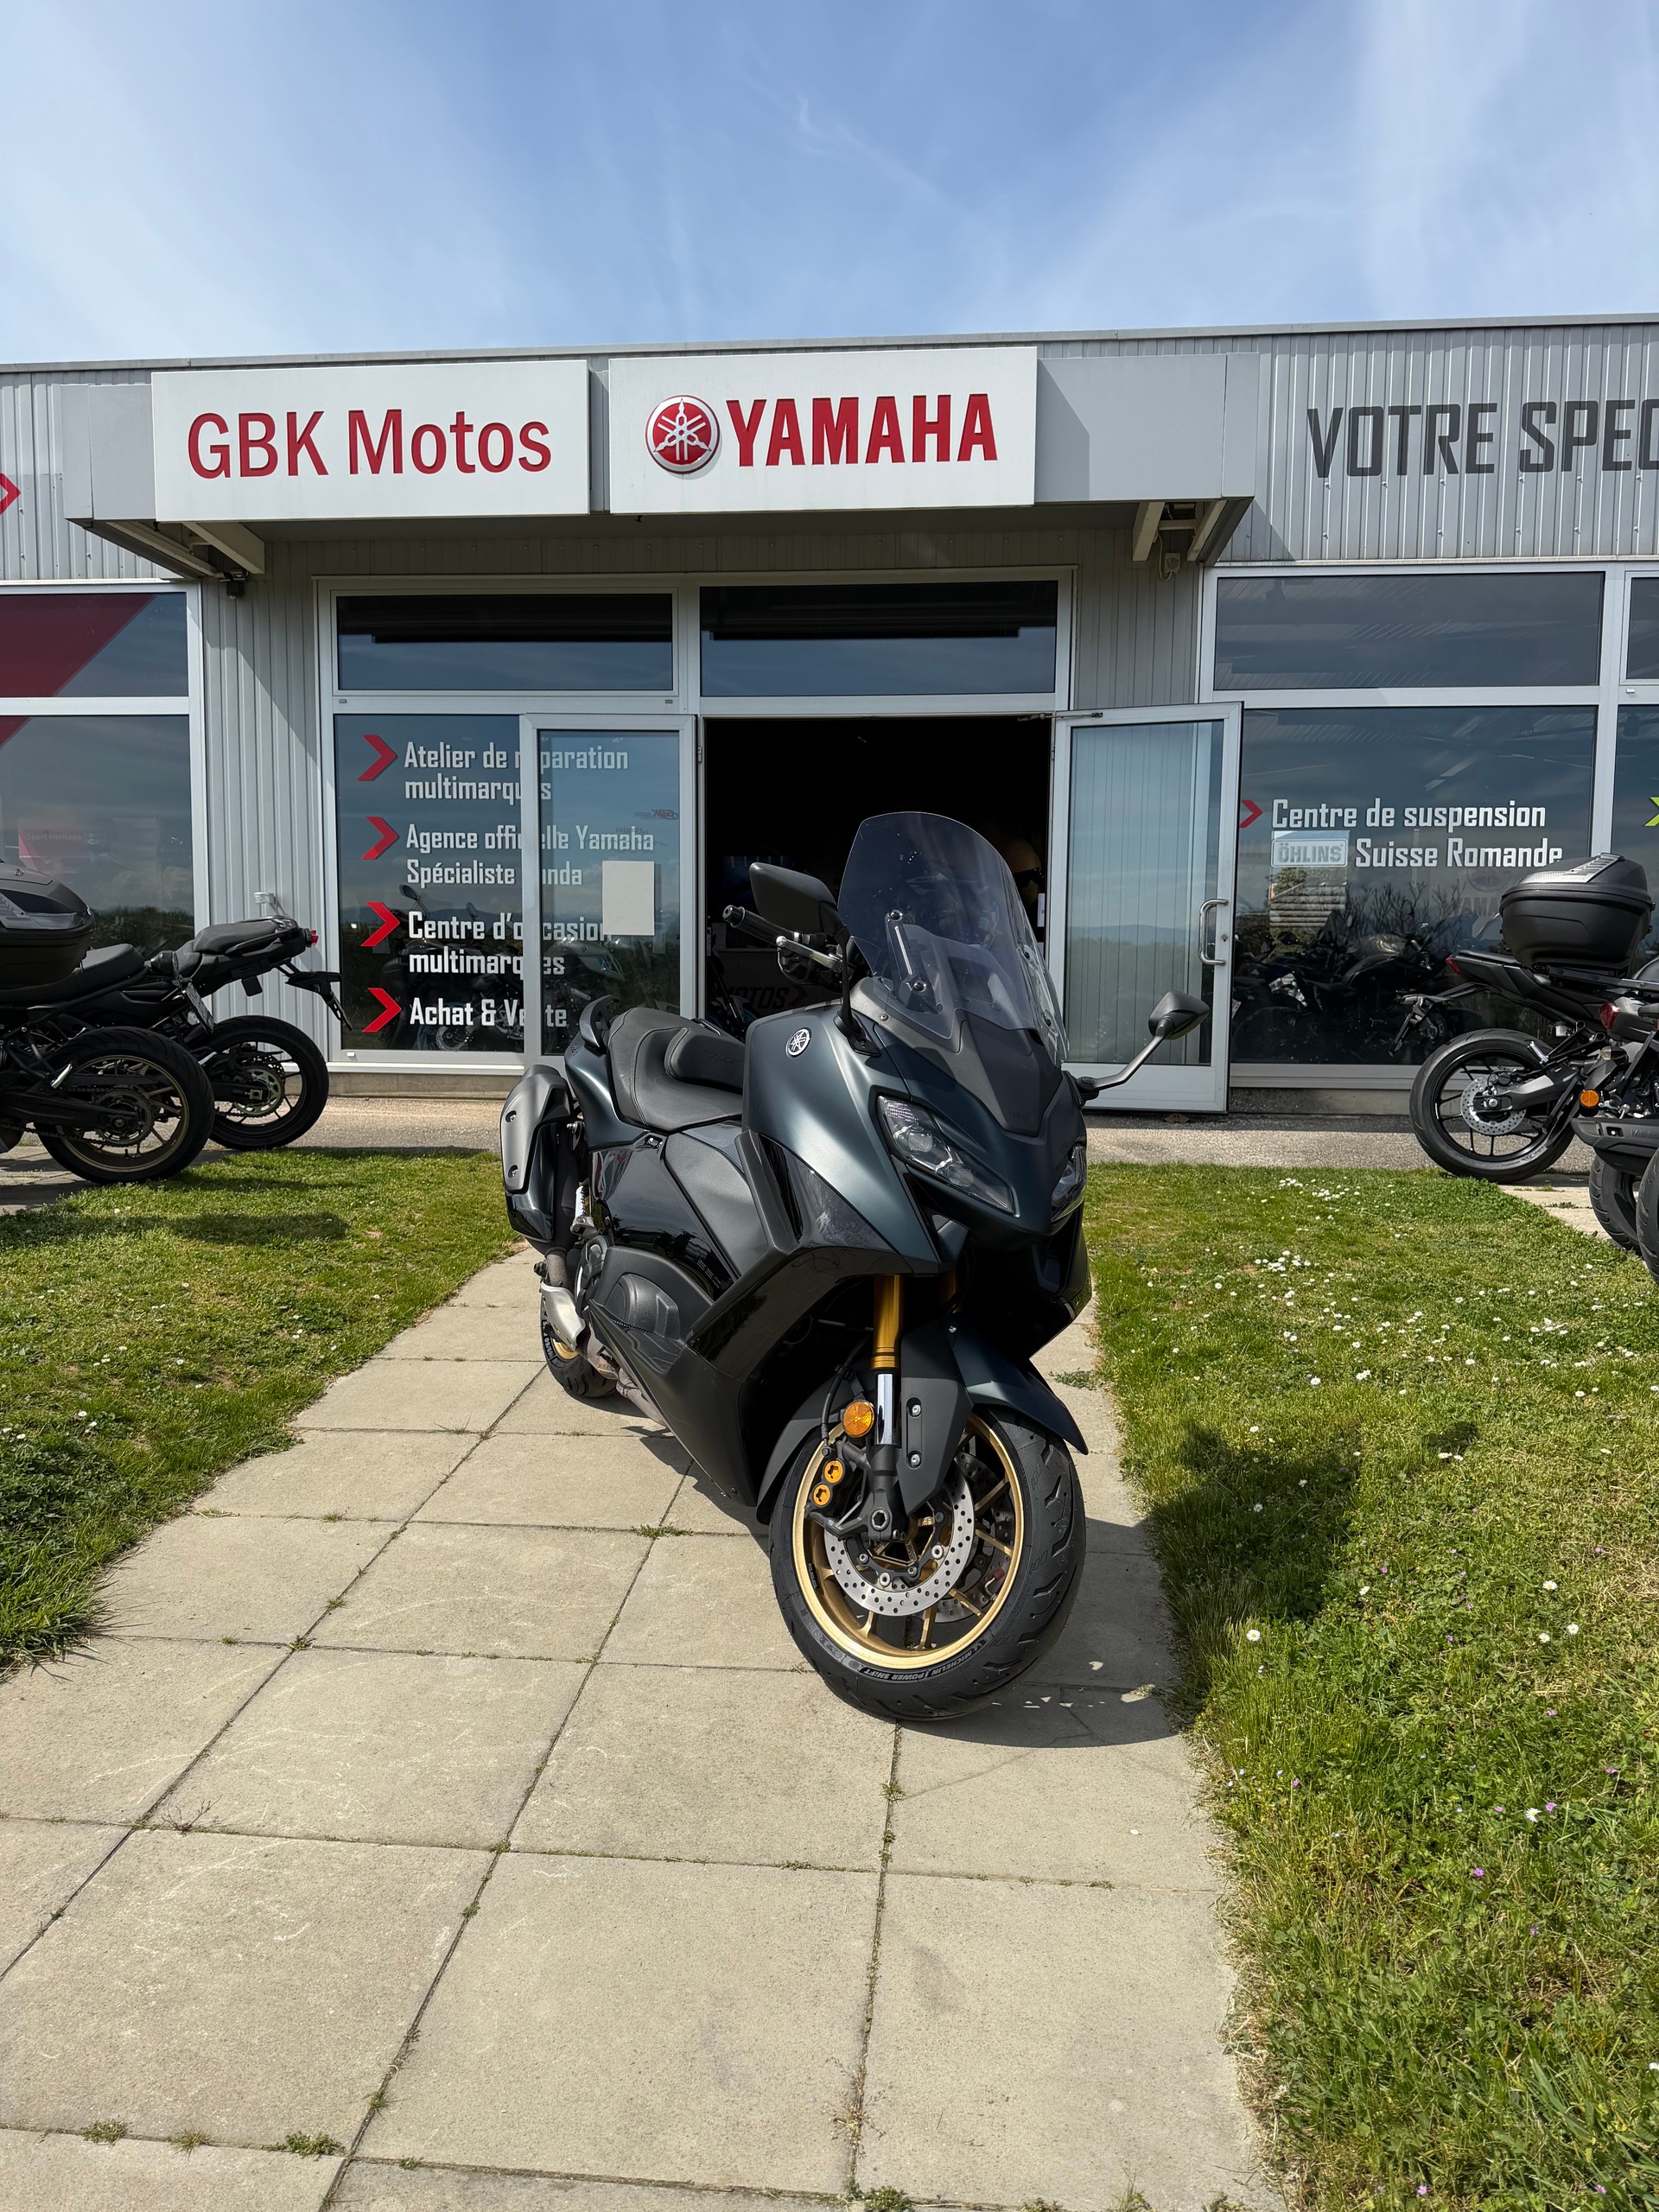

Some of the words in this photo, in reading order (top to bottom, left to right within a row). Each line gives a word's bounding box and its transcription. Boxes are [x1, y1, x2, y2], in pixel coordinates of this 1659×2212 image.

[188, 410, 328, 479] GBK
[348, 409, 552, 475] Motos
[726, 393, 998, 467] YAMAHA
[1306, 402, 1497, 478] VOTRE
[1519, 398, 1659, 473] SPEC
[404, 741, 476, 769] Atelier
[483, 741, 508, 769] de
[514, 745, 629, 775] rparation
[404, 772, 552, 805] multimarqus
[1271, 798, 1357, 829] Centre
[1365, 798, 1395, 828] de
[1403, 800, 1547, 833] suspension
[405, 823, 478, 855] Agence
[485, 824, 569, 850] offille
[575, 824, 654, 851] Yamaha
[1277, 842, 1342, 863] ÖHLINS
[1355, 837, 1438, 868] Suisse
[1446, 837, 1562, 868] Romande
[406, 858, 516, 889] Spécialiste
[542, 861, 583, 886] nda
[408, 911, 486, 940] Centre
[493, 912, 613, 942] d'ocasio
[409, 945, 566, 981] multimarqes
[410, 996, 474, 1027] Achat
[481, 998, 497, 1027] &
[503, 999, 568, 1027] Vete
[892, 1671, 924, 1681] POWER
[931, 1650, 972, 1675] MICHELIN
